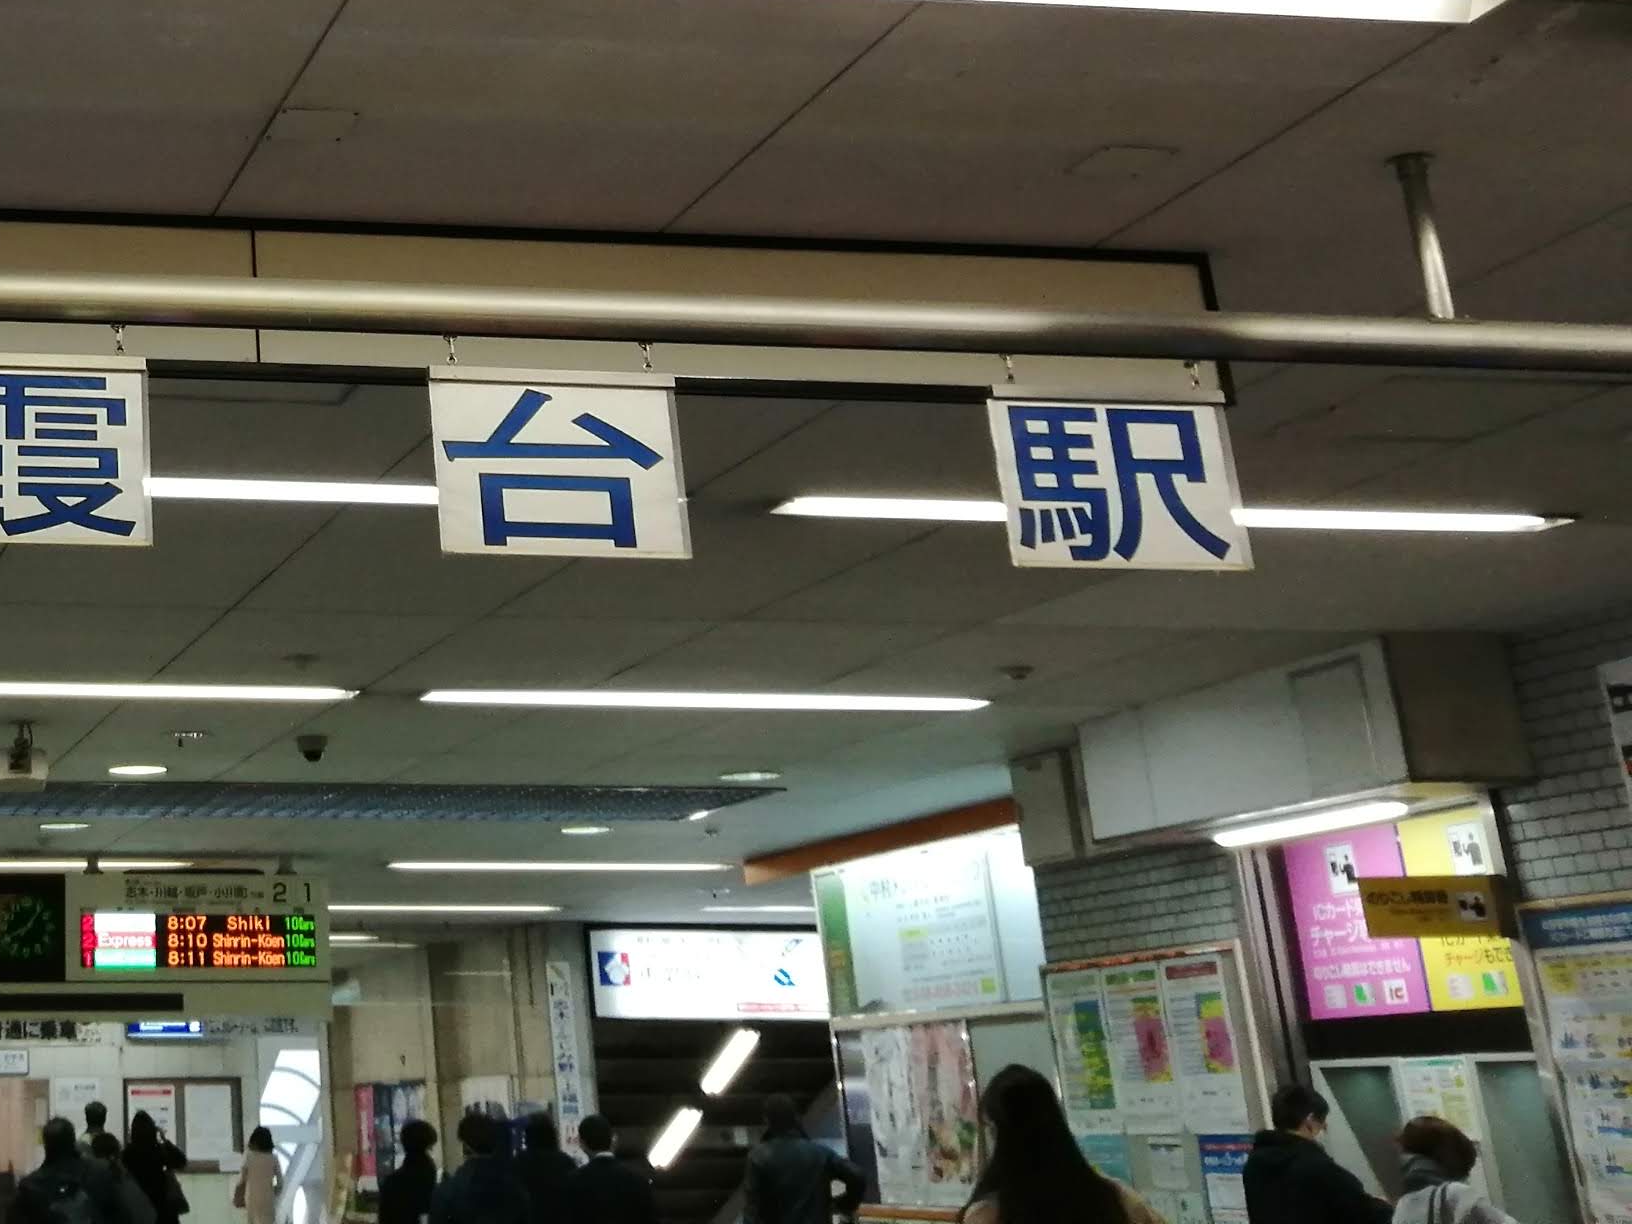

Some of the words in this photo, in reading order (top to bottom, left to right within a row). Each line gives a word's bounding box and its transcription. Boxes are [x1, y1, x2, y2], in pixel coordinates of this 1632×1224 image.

[442, 388, 664, 548] 台
[1008, 405, 1232, 562] 駅
[272, 882, 287, 903] 2
[303, 882, 312, 903] 1
[168, 916, 208, 930] 8:07
[227, 915, 271, 931] Shiki
[97, 932, 153, 950] Express
[168, 933, 208, 948] 8:10
[168, 951, 206, 966] 8:11
